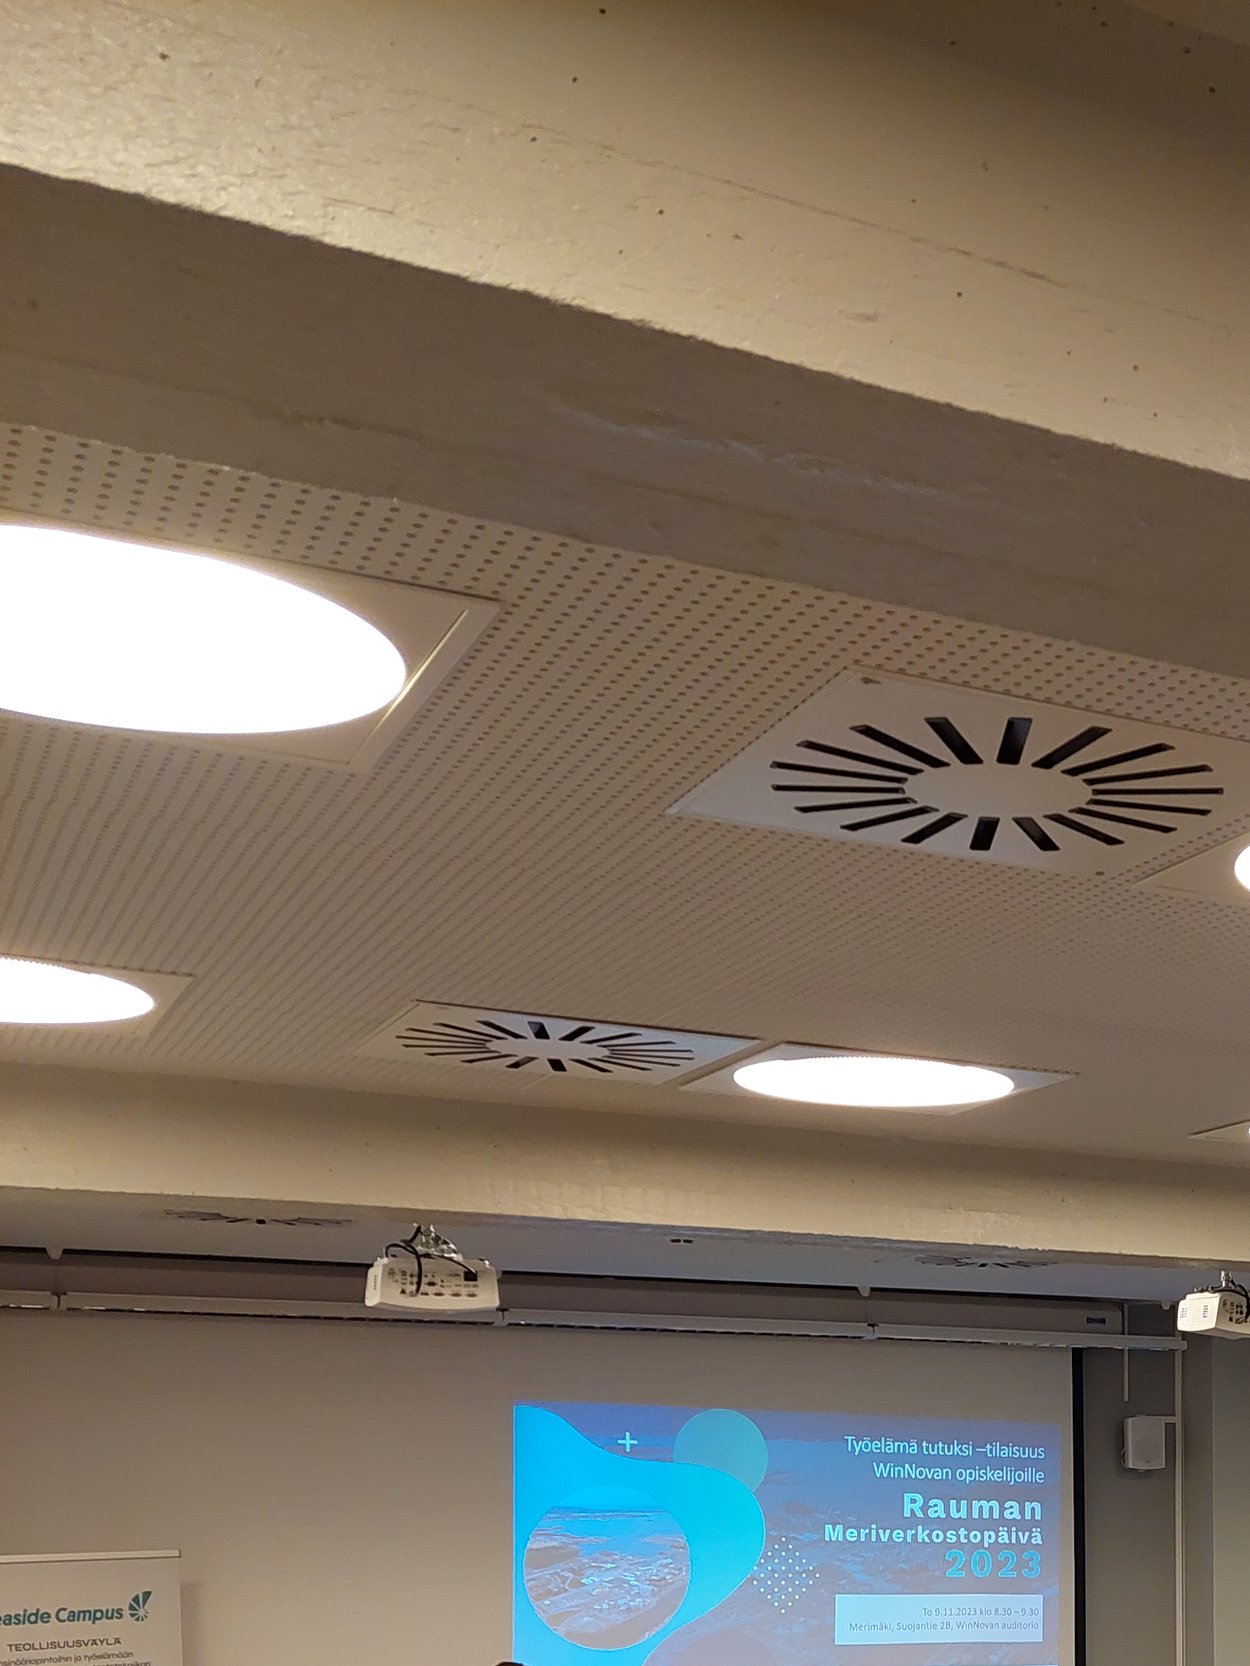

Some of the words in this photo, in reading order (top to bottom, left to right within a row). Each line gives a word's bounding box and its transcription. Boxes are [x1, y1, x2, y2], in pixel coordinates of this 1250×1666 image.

[844, 1436, 918, 1456] Työelämä
[922, 1440, 973, 1456] tutuksi
[873, 1462, 952, 1480] WinNovan
[956, 1466, 1045, 1486] opiskelijoille
[903, 1492, 1042, 1520] Rauman
[824, 1524, 1043, 1548] Meriverkostopäivä
[944, 1549, 1042, 1578] 2023
[55, 1607, 124, 1625] Campus
[923, 1607, 933, 1617] To
[934, 1607, 977, 1617] 9.11.2023
[979, 1607, 992, 1617] klo
[994, 1608, 1012, 1617] 8.30
[1021, 1608, 1039, 1617] 9.30
[897, 1621, 938, 1633] Suojantie
[956, 1621, 1000, 1630] WinNovan
[1002, 1621, 1039, 1630] auditorio
[7, 1637, 122, 1653] TEOLLISUUSVÄYLÄ
[74, 1654, 82, 1664] ja
